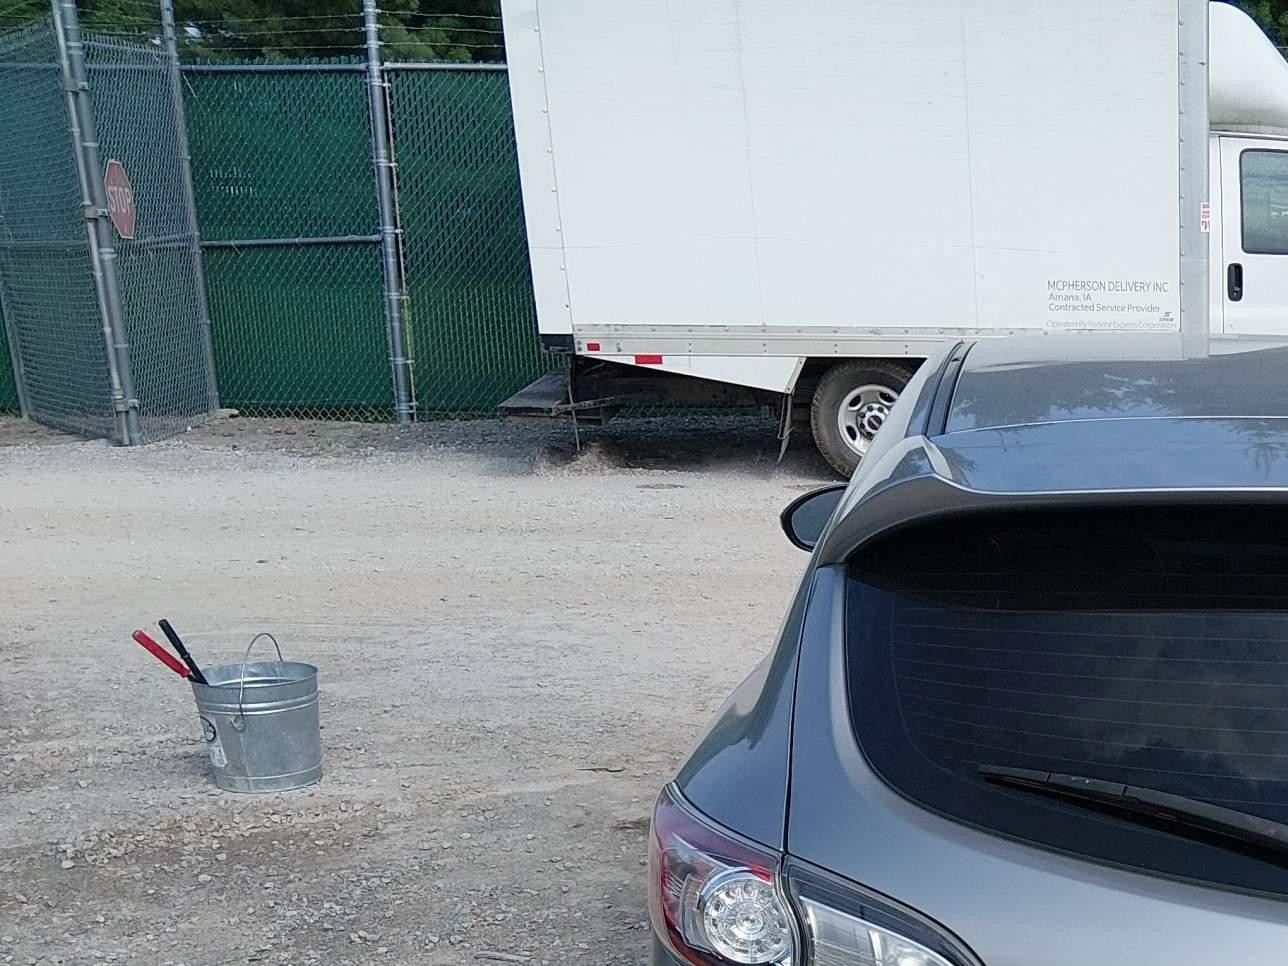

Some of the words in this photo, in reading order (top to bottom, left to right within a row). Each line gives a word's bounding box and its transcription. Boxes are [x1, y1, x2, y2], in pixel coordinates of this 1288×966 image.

[107, 186, 131, 215] STOP
[1047, 280, 1106, 292] MCPHERSON
[1108, 281, 1151, 293] DELIVERY
[1153, 282, 1169, 293] INC
[1049, 293, 1081, 302] Amana,
[1082, 293, 1093, 302] IA
[1048, 303, 1095, 312] Contracted
[1096, 304, 1126, 312] Service
[1127, 304, 1160, 313] Provider
